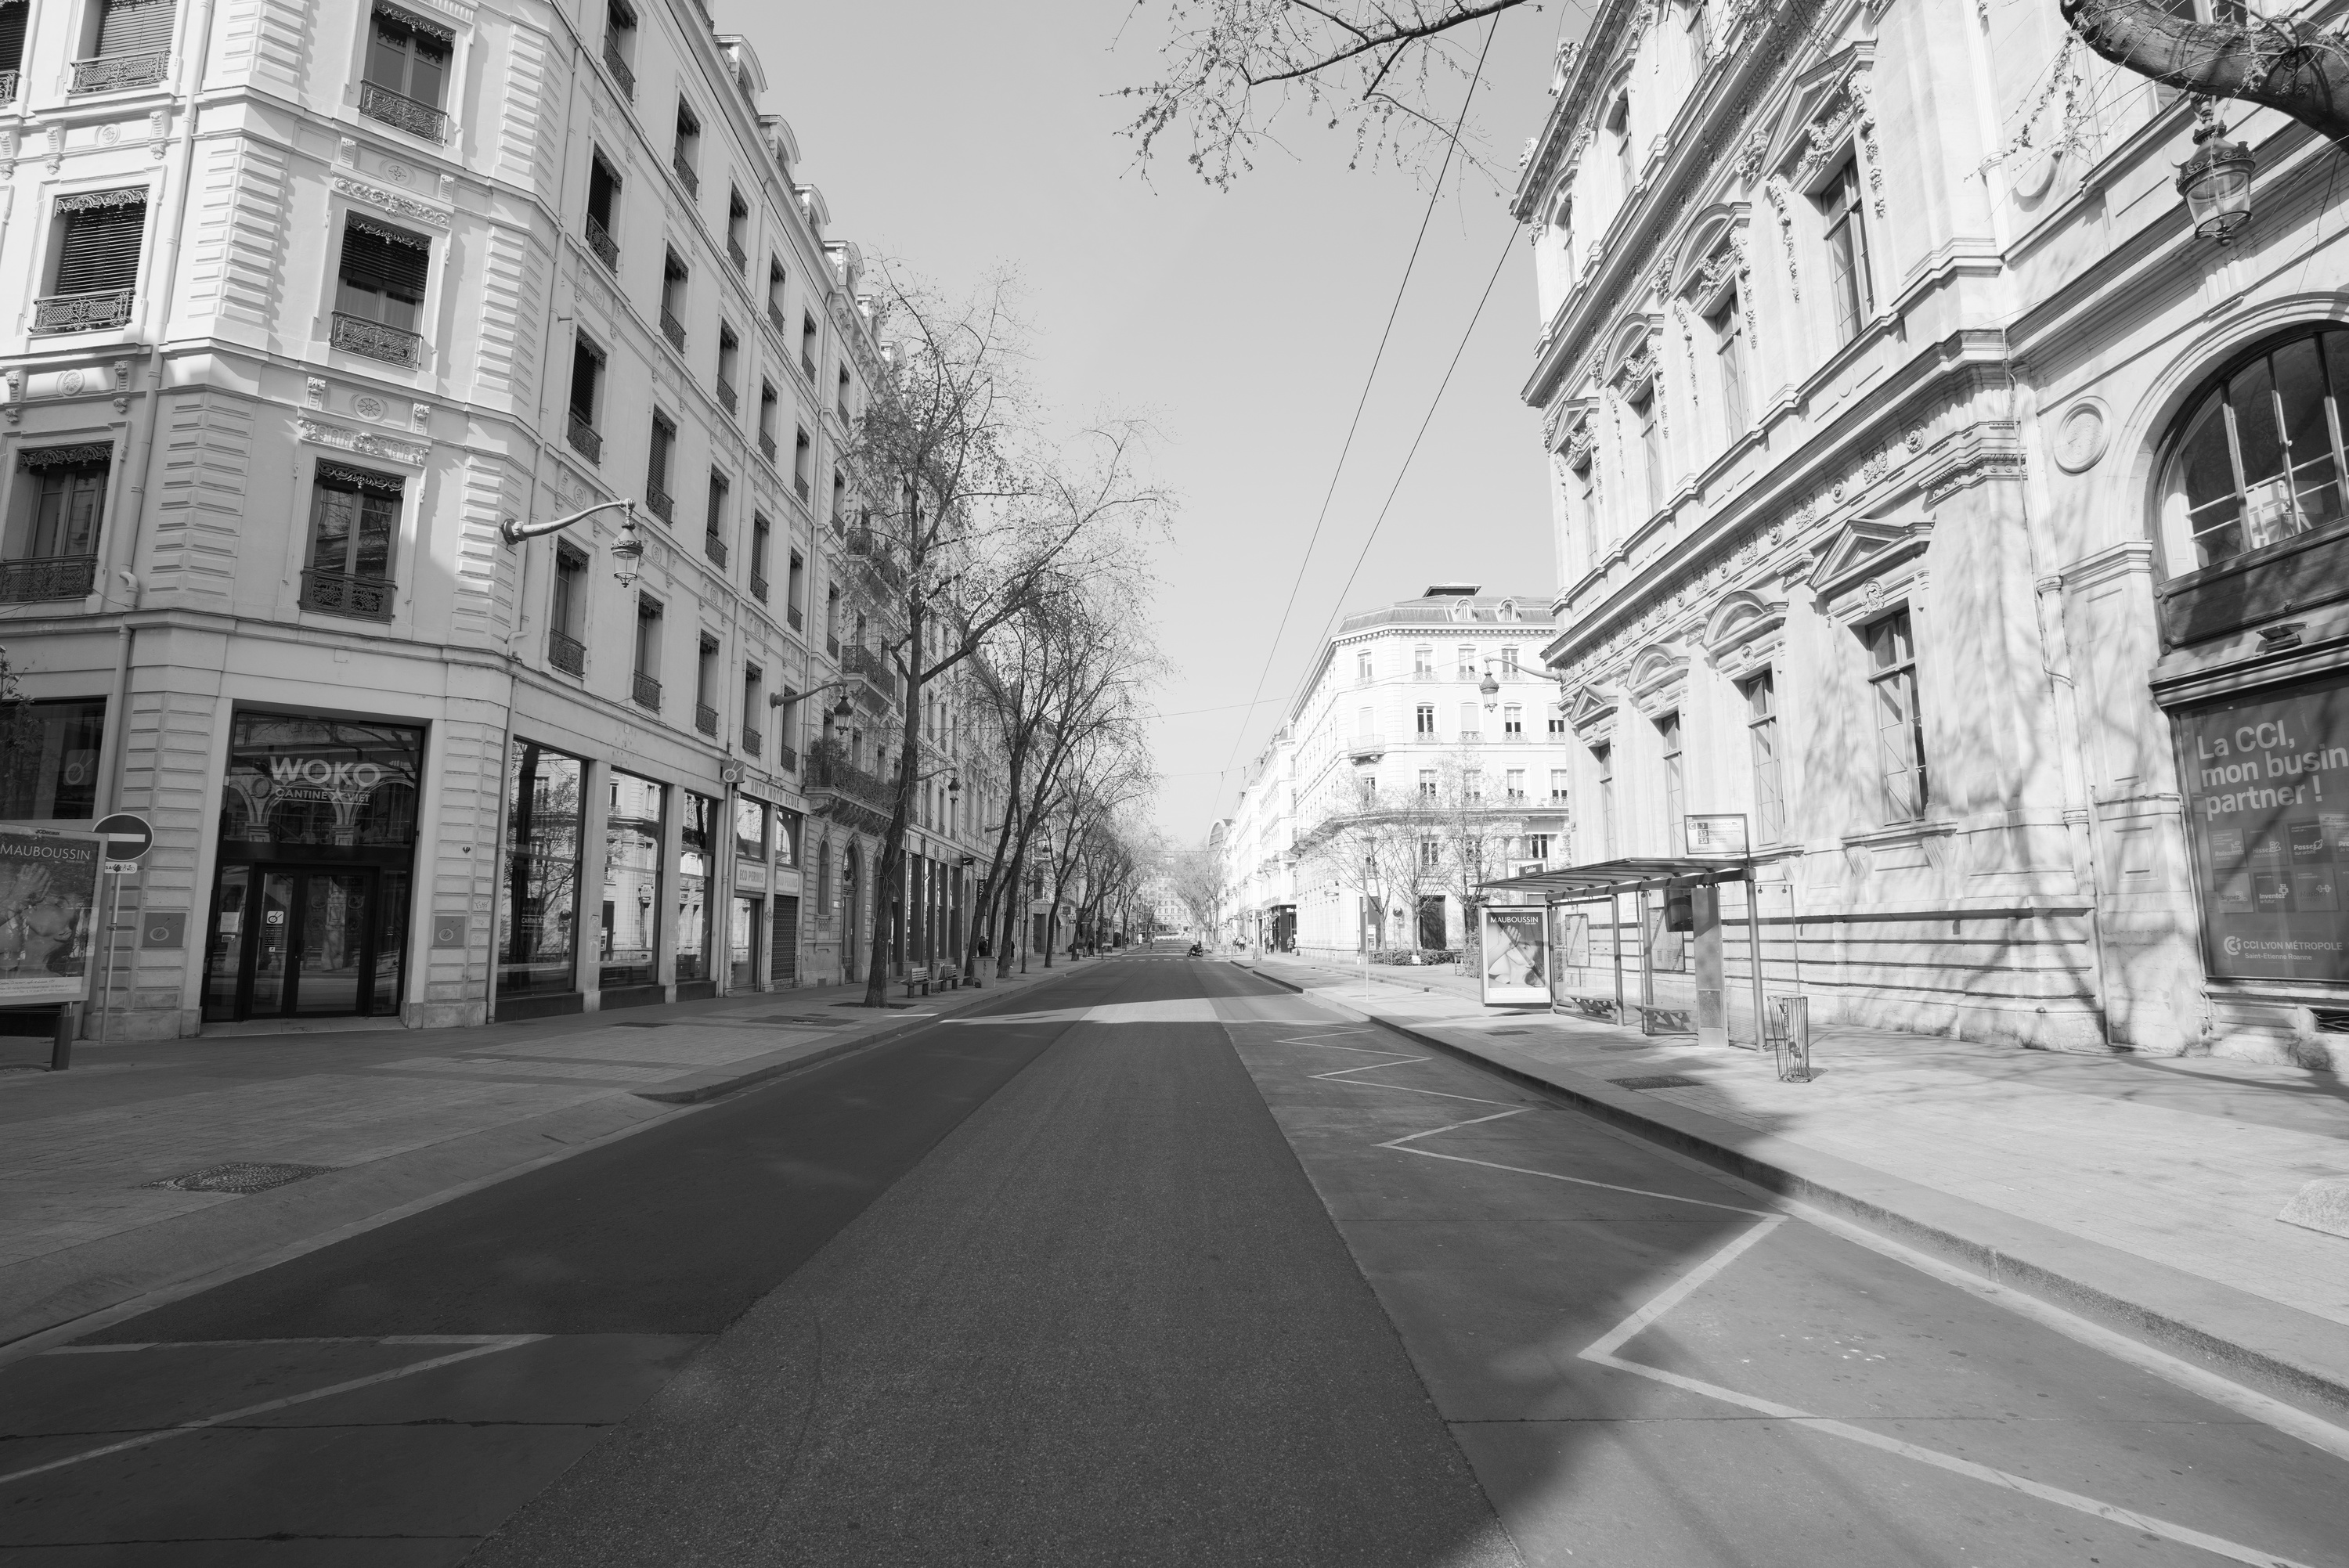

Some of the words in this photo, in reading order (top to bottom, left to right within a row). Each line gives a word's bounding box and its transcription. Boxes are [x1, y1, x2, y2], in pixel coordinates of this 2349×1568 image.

[2197, 735, 2229, 760] La
[2235, 719, 2295, 752] CCI,
[269, 755, 381, 788] WOKO
[2201, 761, 2259, 788] mon
[2264, 744, 2349, 778] busin
[275, 788, 328, 800] CANTINE
[347, 793, 370, 802] VIET
[751, 780, 766, 797] AUTO
[767, 787, 783, 803] MOTO
[785, 793, 799, 809] ECOLE
[2205, 784, 2306, 821] partner
[0, 844, 91, 860] MAUBOUSSIN
[739, 869, 748, 881] ECO
[748, 871, 764, 883] PERMIS
[2243, 940, 2259, 950] CCI
[2261, 941, 2284, 950] LYON
[2285, 939, 2344, 950] MÉTROPOLE
